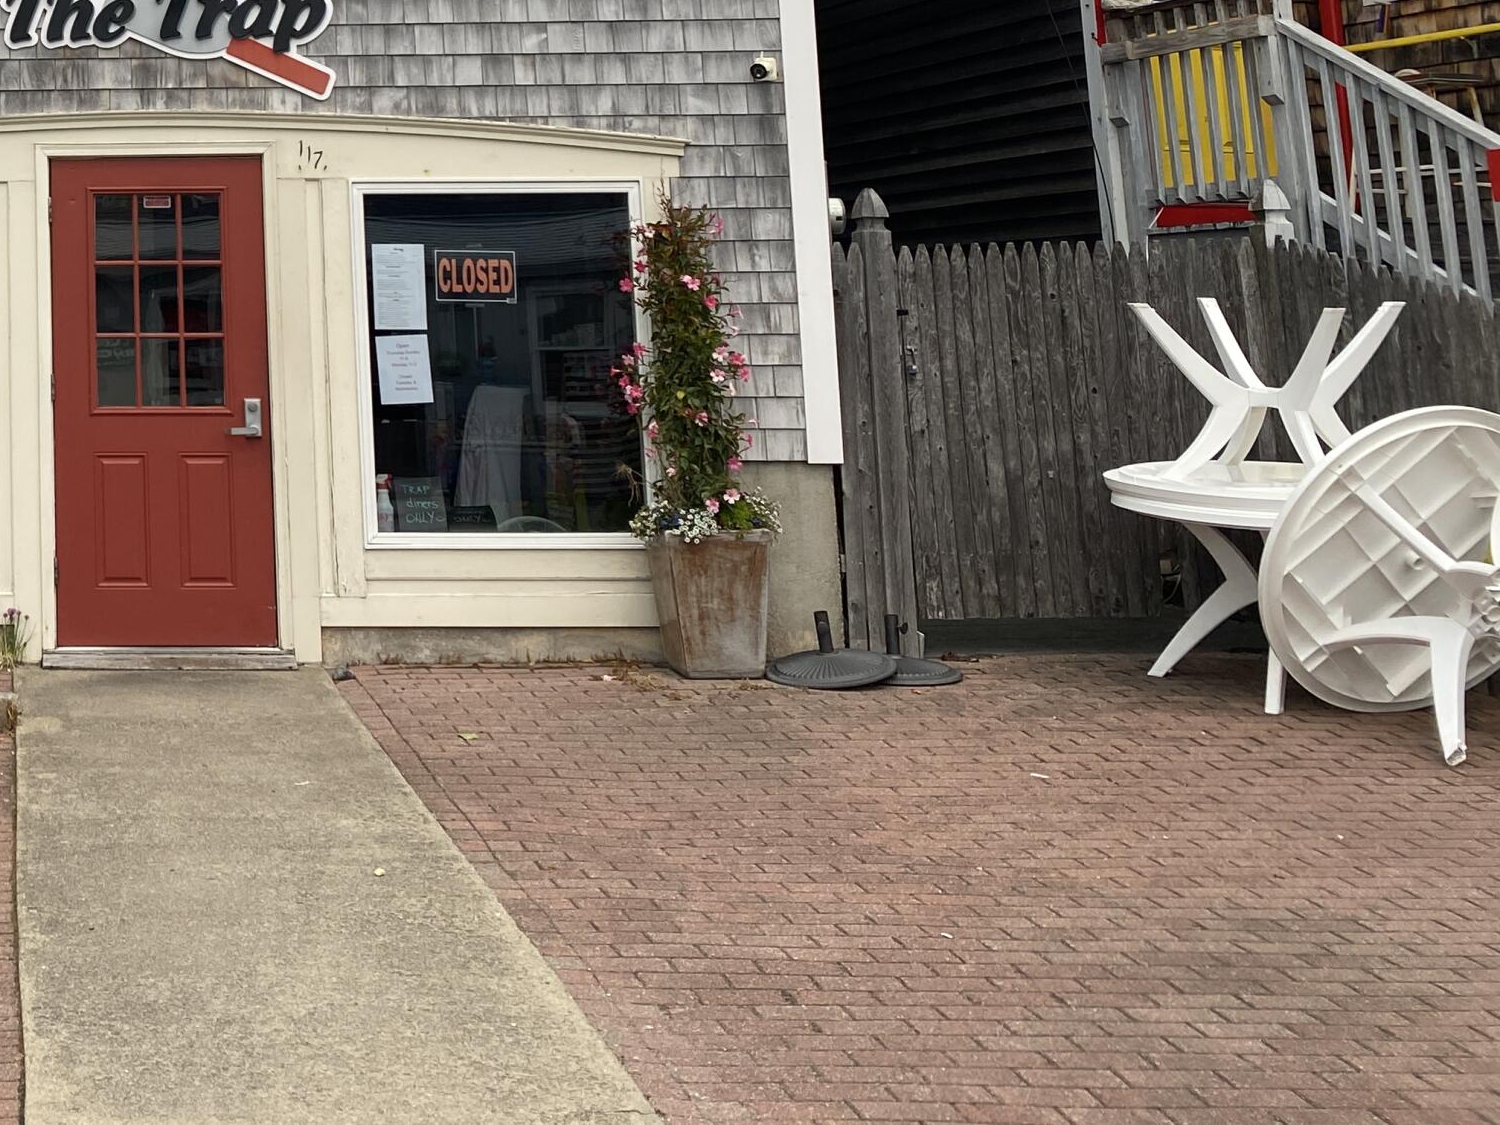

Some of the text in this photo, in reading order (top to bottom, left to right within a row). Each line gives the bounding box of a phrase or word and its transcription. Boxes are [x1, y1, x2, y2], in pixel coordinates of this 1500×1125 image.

[439, 258, 513, 293] CLOSED
[402, 485, 431, 495] TRAP
[406, 497, 438, 509] diners
[406, 512, 435, 523] ONLY
